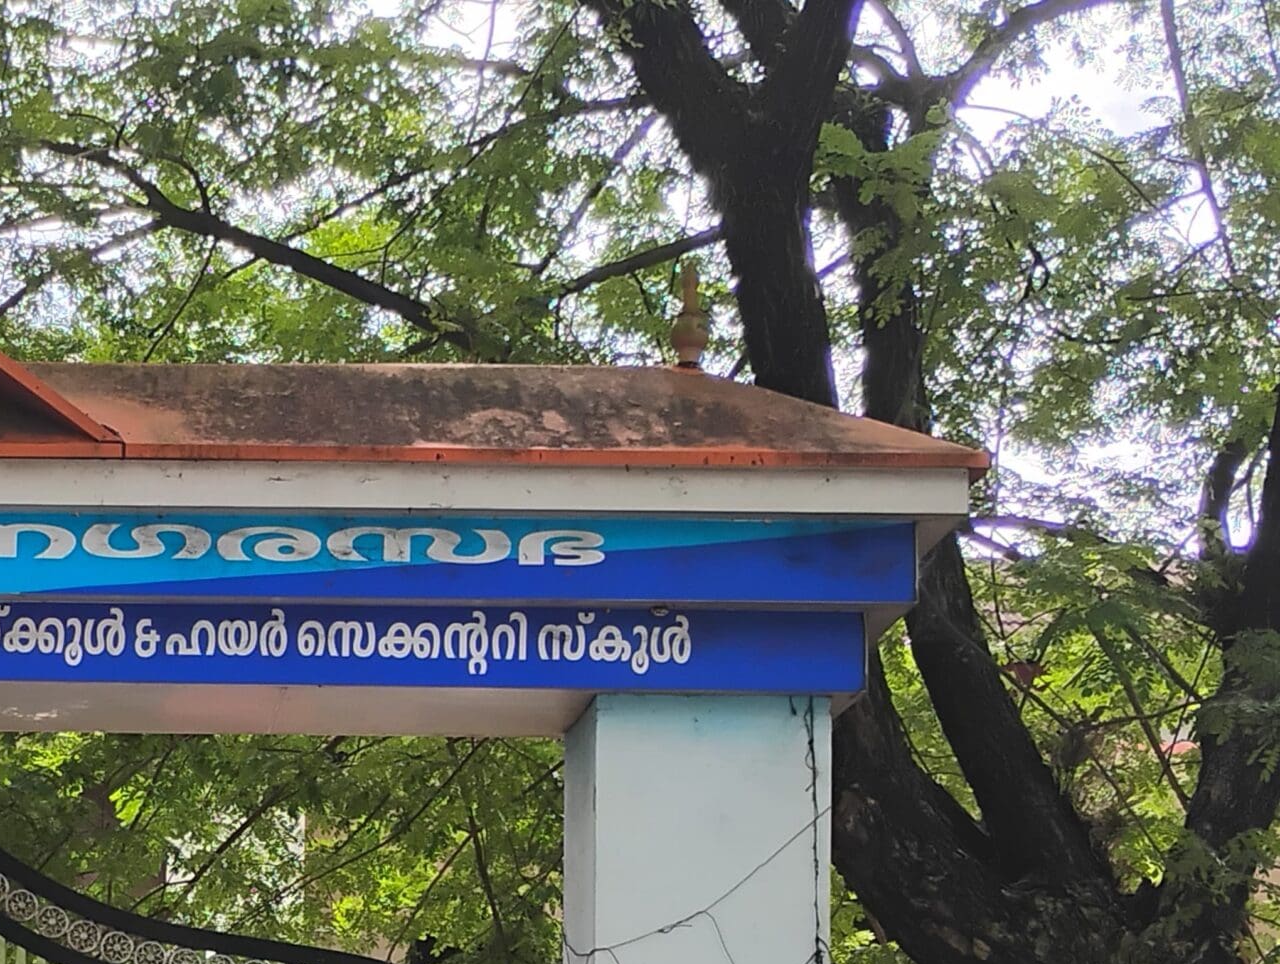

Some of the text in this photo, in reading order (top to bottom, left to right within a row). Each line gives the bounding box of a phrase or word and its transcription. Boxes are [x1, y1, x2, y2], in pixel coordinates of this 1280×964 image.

[134, 617, 162, 659] &
[165, 609, 288, 659] ഹയർ
[538, 613, 692, 675] സ്കൂൾ
